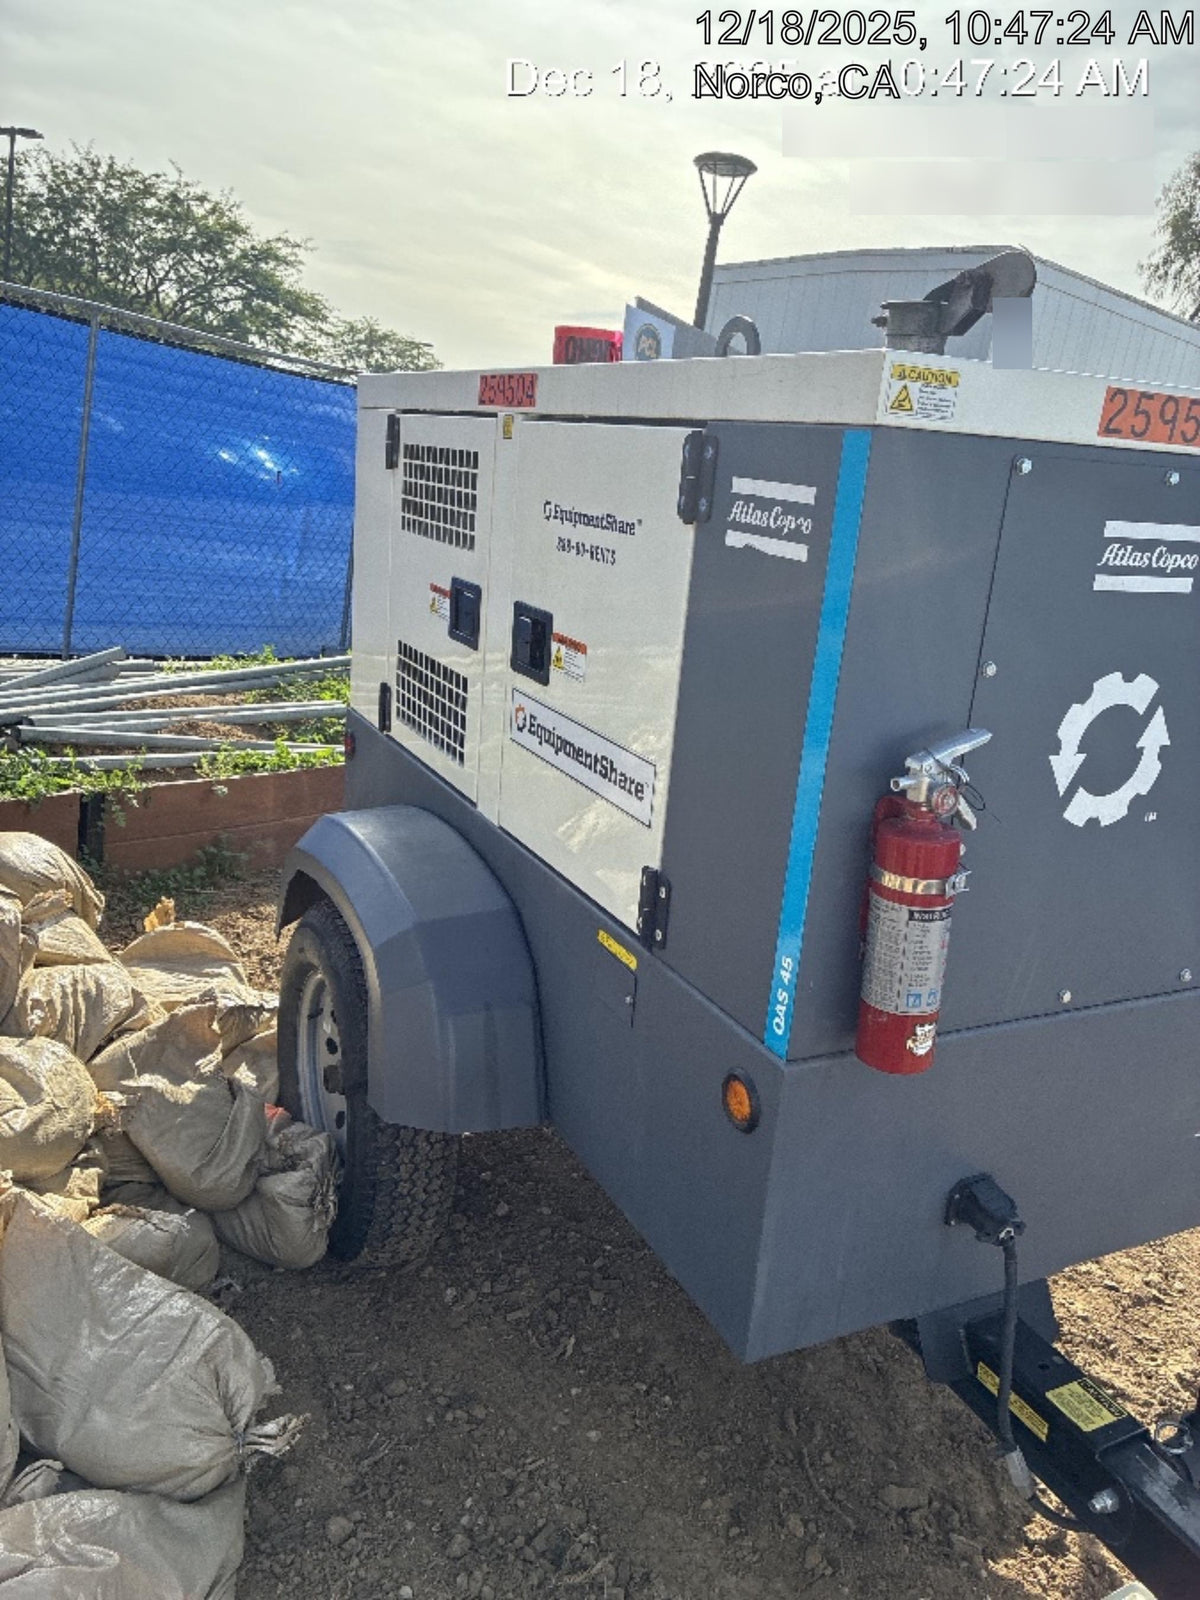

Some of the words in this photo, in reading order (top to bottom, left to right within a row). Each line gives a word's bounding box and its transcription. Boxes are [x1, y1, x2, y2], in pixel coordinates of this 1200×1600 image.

[478, 374, 536, 406] 259504
[908, 369, 952, 385] CAUTION
[527, 714, 645, 802] EquipmentShare
[772, 988, 789, 1035] QAS
[781, 956, 793, 985] 45
